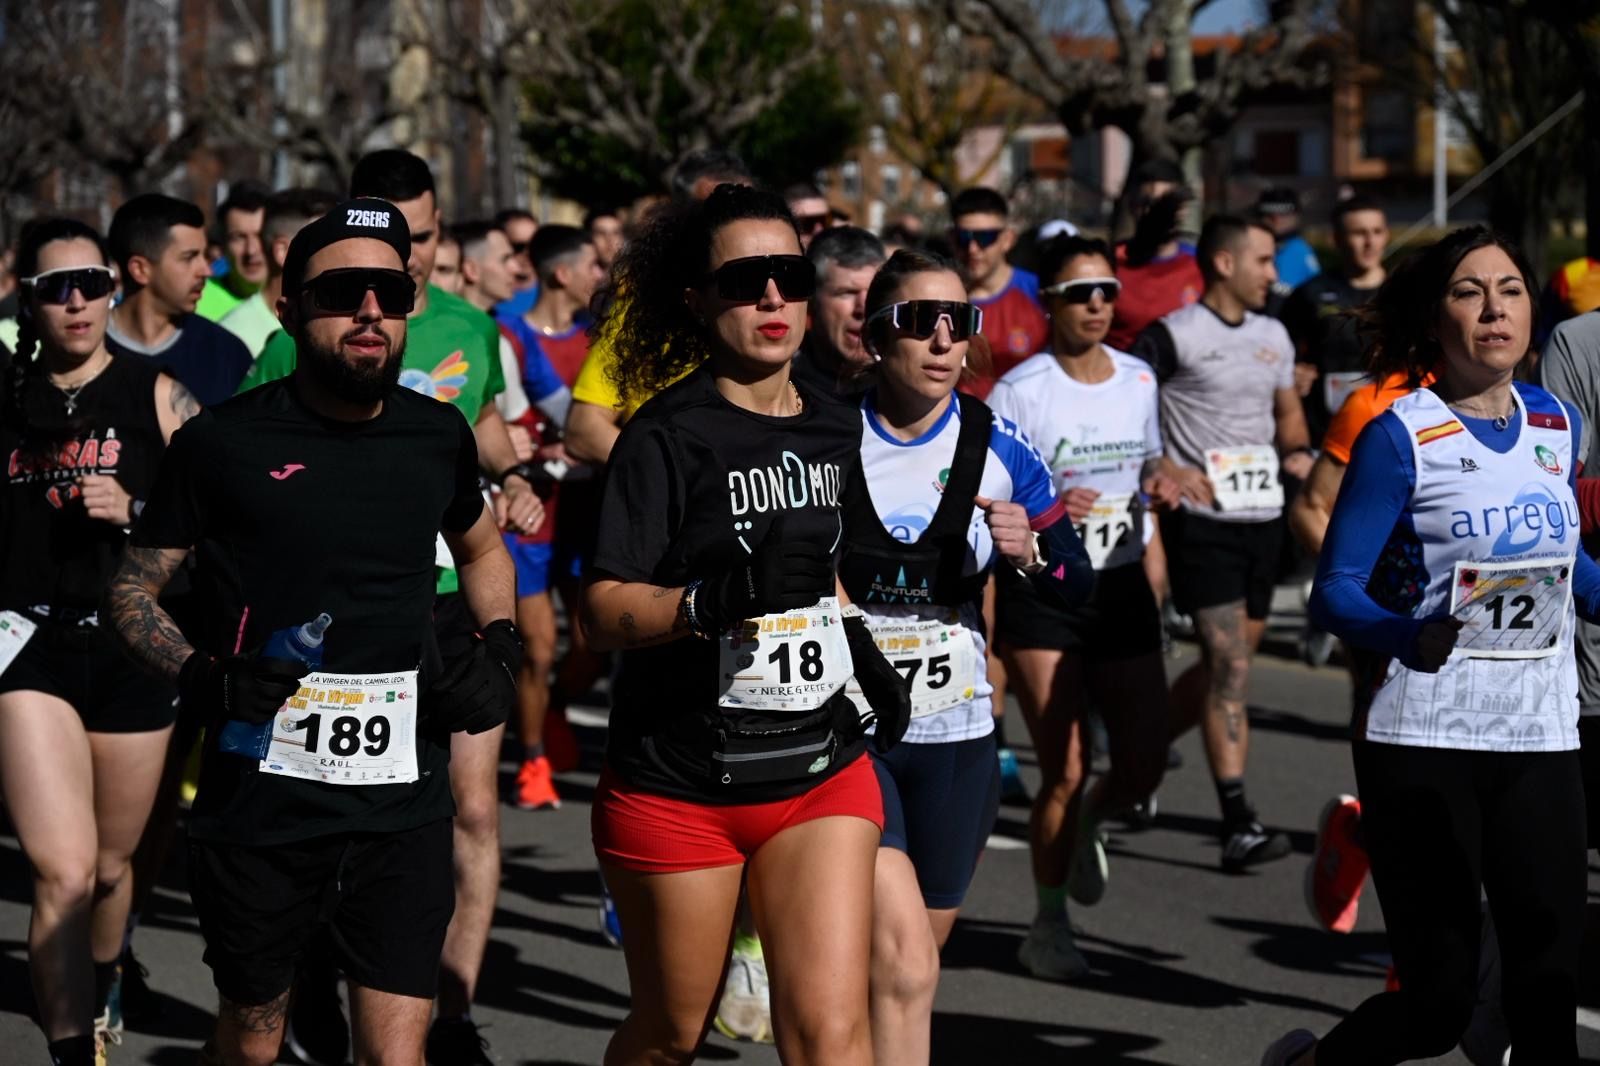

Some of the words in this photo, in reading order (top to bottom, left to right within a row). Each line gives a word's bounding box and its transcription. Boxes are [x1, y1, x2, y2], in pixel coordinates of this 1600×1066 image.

[346, 209, 390, 228] 226ERS
[1226, 469, 1272, 492] 172
[1074, 521, 1130, 548] 112
[871, 583, 929, 597] RUNITUDE
[1485, 594, 1536, 631] 12
[880, 625, 904, 633] VIRGEN
[768, 640, 824, 684] 18
[893, 653, 952, 690] 75
[322, 677, 350, 685] VIRGEN
[310, 688, 326, 702] La
[327, 689, 366, 705] Virgen
[296, 713, 391, 757] 189
[320, 758, 352, 768] RAUL
